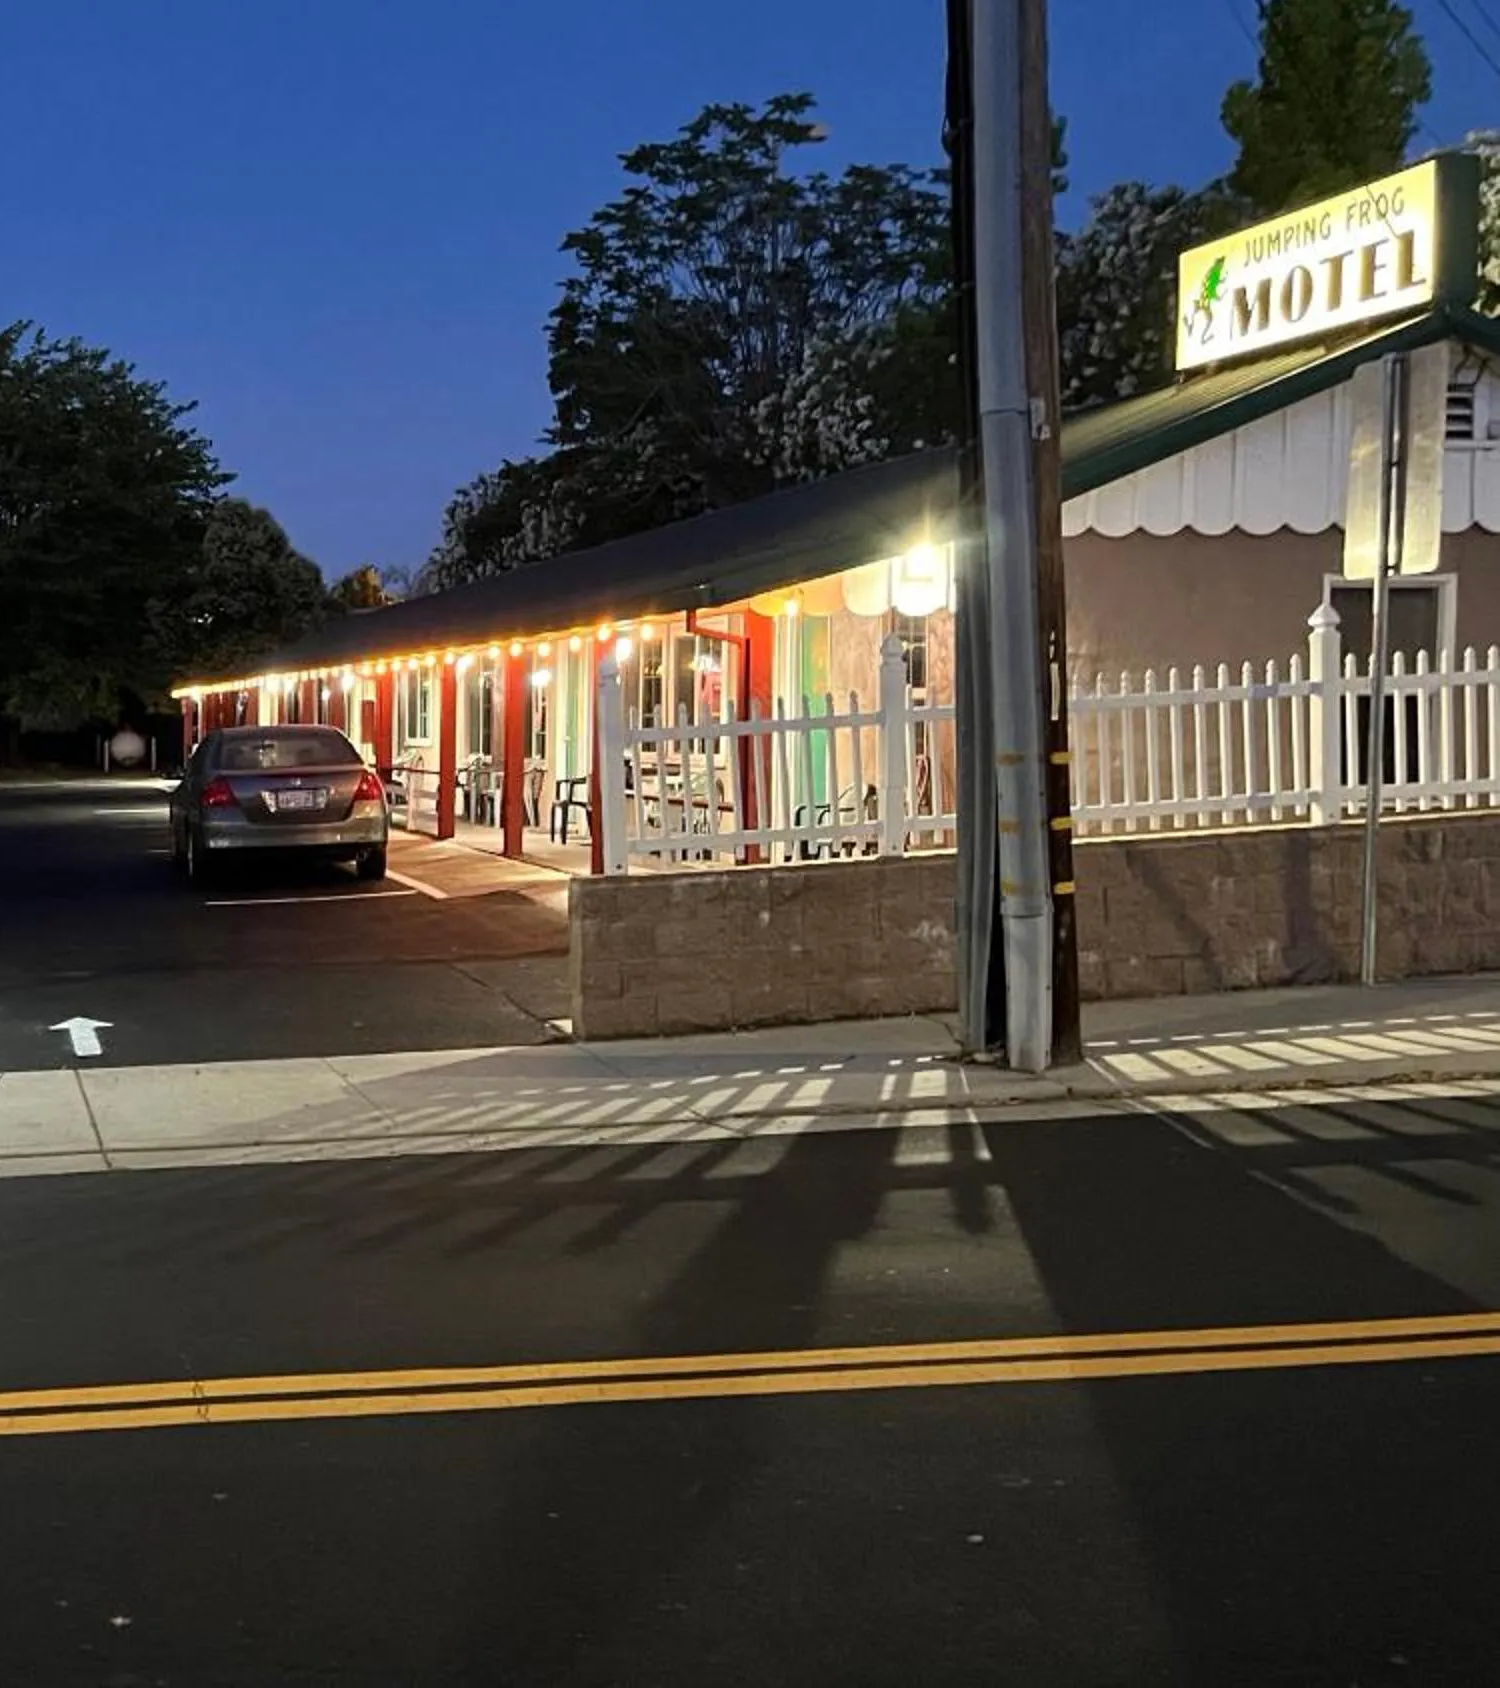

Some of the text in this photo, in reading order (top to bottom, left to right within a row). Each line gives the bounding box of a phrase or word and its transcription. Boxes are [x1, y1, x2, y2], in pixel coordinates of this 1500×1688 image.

[1243, 187, 1405, 268] JUMPING FROG
[1230, 230, 1427, 338] MOTEL
